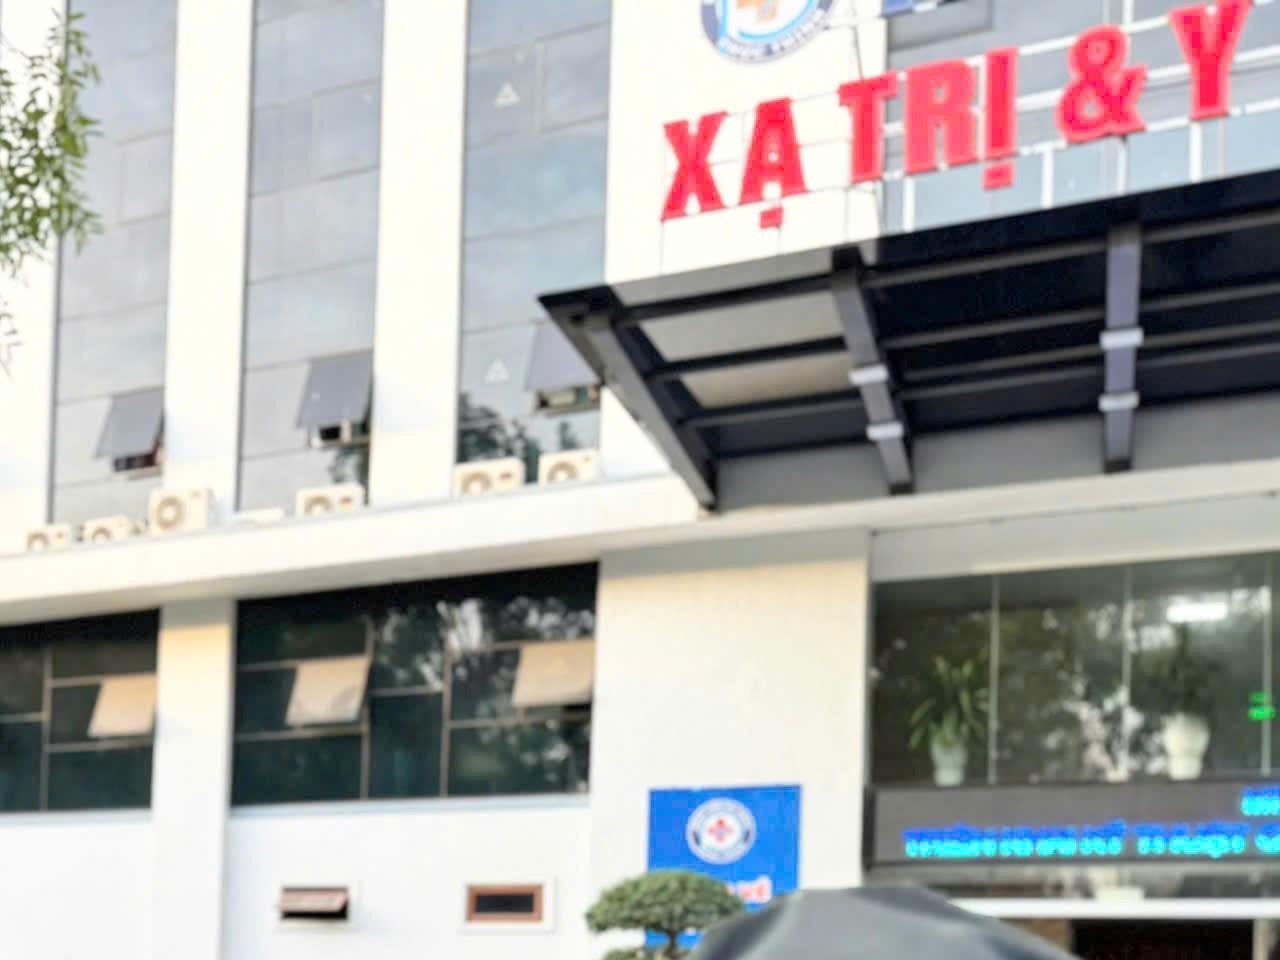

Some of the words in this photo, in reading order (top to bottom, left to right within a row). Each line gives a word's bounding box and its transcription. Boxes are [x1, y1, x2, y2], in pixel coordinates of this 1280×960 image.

[660, 97, 809, 229] XẠ
[837, 47, 1019, 191] TRỊ
[1054, 24, 1148, 145] &
[1169, 0, 1254, 121] Y
